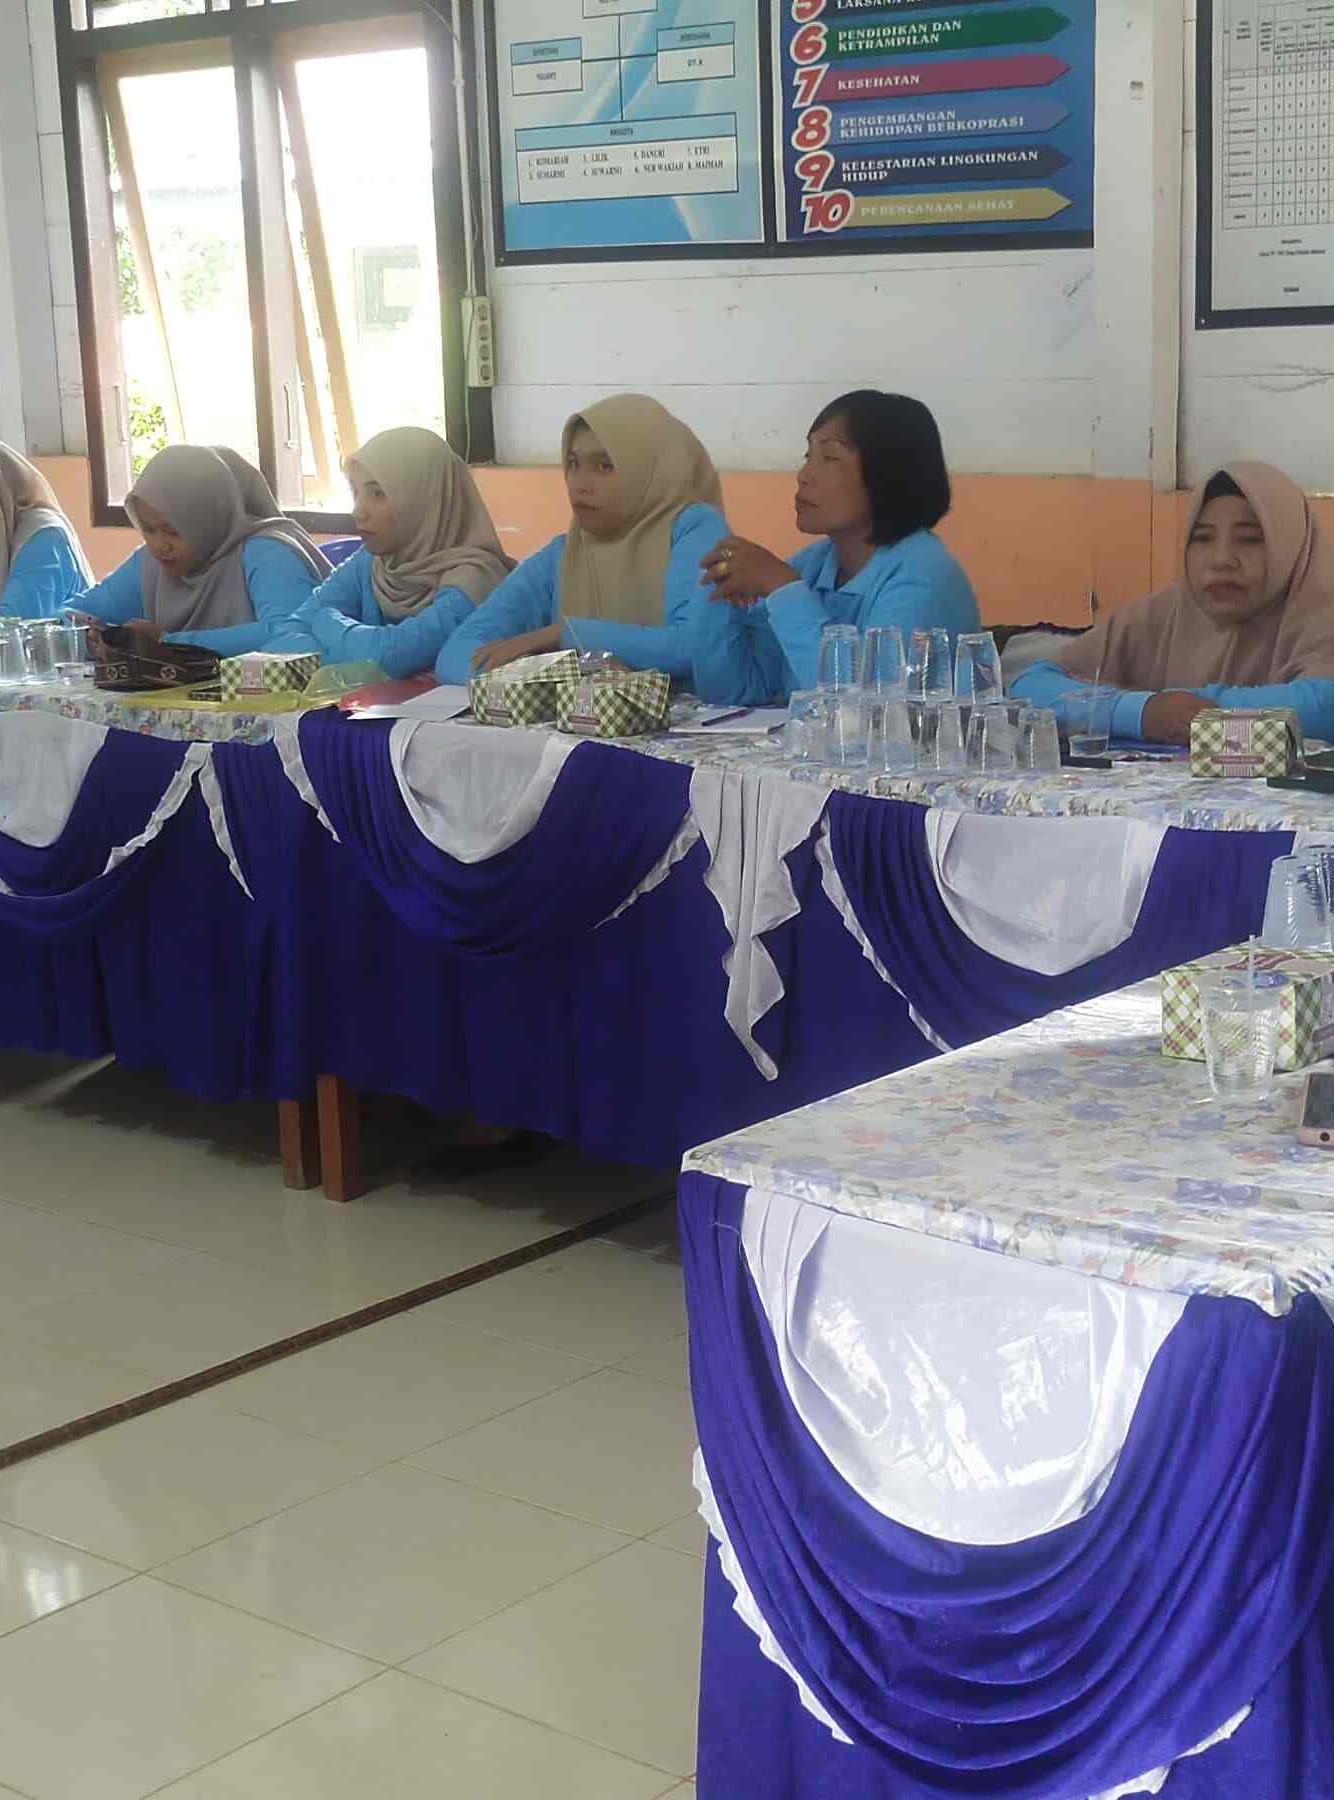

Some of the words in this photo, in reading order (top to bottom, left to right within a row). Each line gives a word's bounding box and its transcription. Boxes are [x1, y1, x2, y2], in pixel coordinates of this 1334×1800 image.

[838, 24, 927, 41] PENDIDIKAN
[932, 20, 962, 32] DAN
[790, 22, 828, 65] 6
[838, 34, 939, 51] KETRAMPILAN
[792, 63, 829, 108] 7
[838, 74, 920, 90] KESEHATAN
[791, 105, 832, 151] 8
[840, 110, 956, 127] PENGEMBANGAN
[840, 123, 923, 138] KEHIDUPAN
[927, 116, 1024, 133] BERKOPRASI
[795, 150, 835, 191] 9
[842, 157, 936, 172] KELESTARIAN
[941, 151, 1039, 166] LINGKUNGAN
[842, 171, 888, 183] HIDUP
[801, 188, 855, 234] 10
